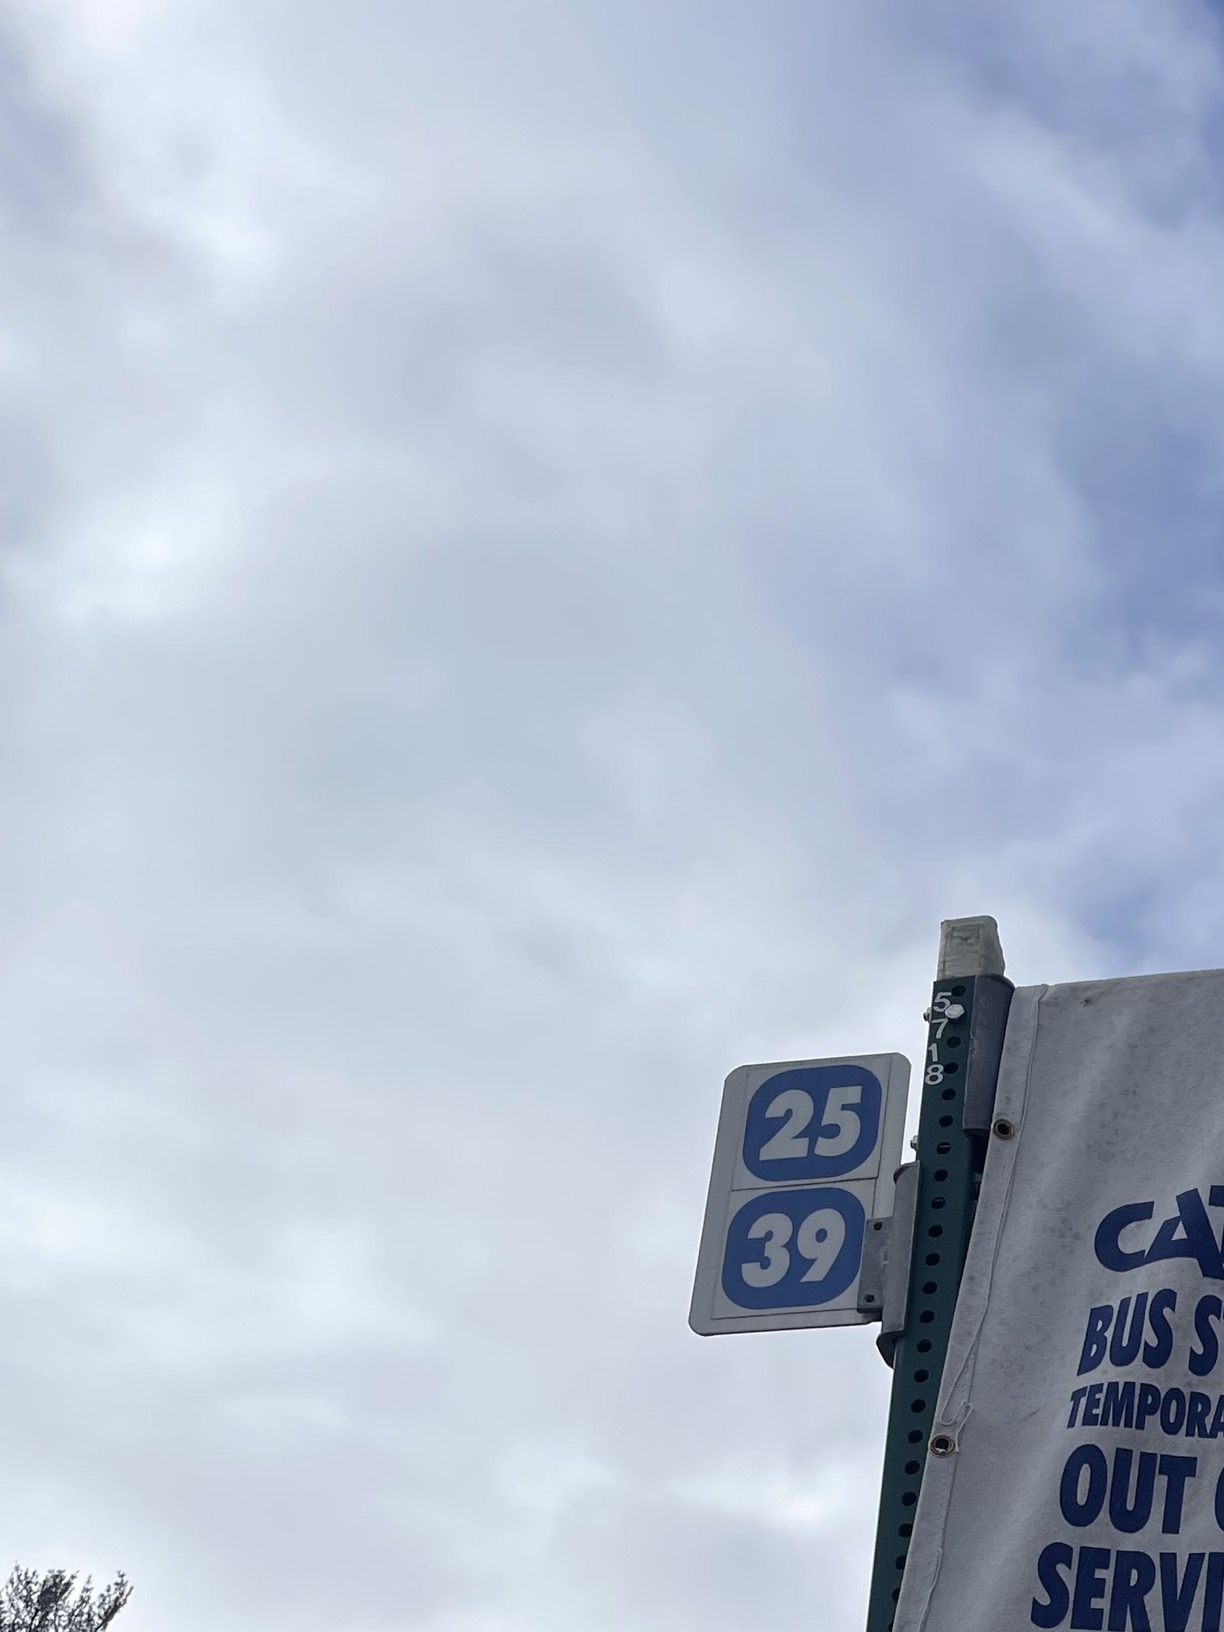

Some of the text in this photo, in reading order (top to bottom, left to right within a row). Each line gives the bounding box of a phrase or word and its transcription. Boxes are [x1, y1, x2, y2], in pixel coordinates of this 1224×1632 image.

[759, 1085, 863, 1161] 25
[741, 1208, 846, 1288] 39
[1077, 1288, 1178, 1377] BUS
[1059, 1444, 1198, 1534] OUT
